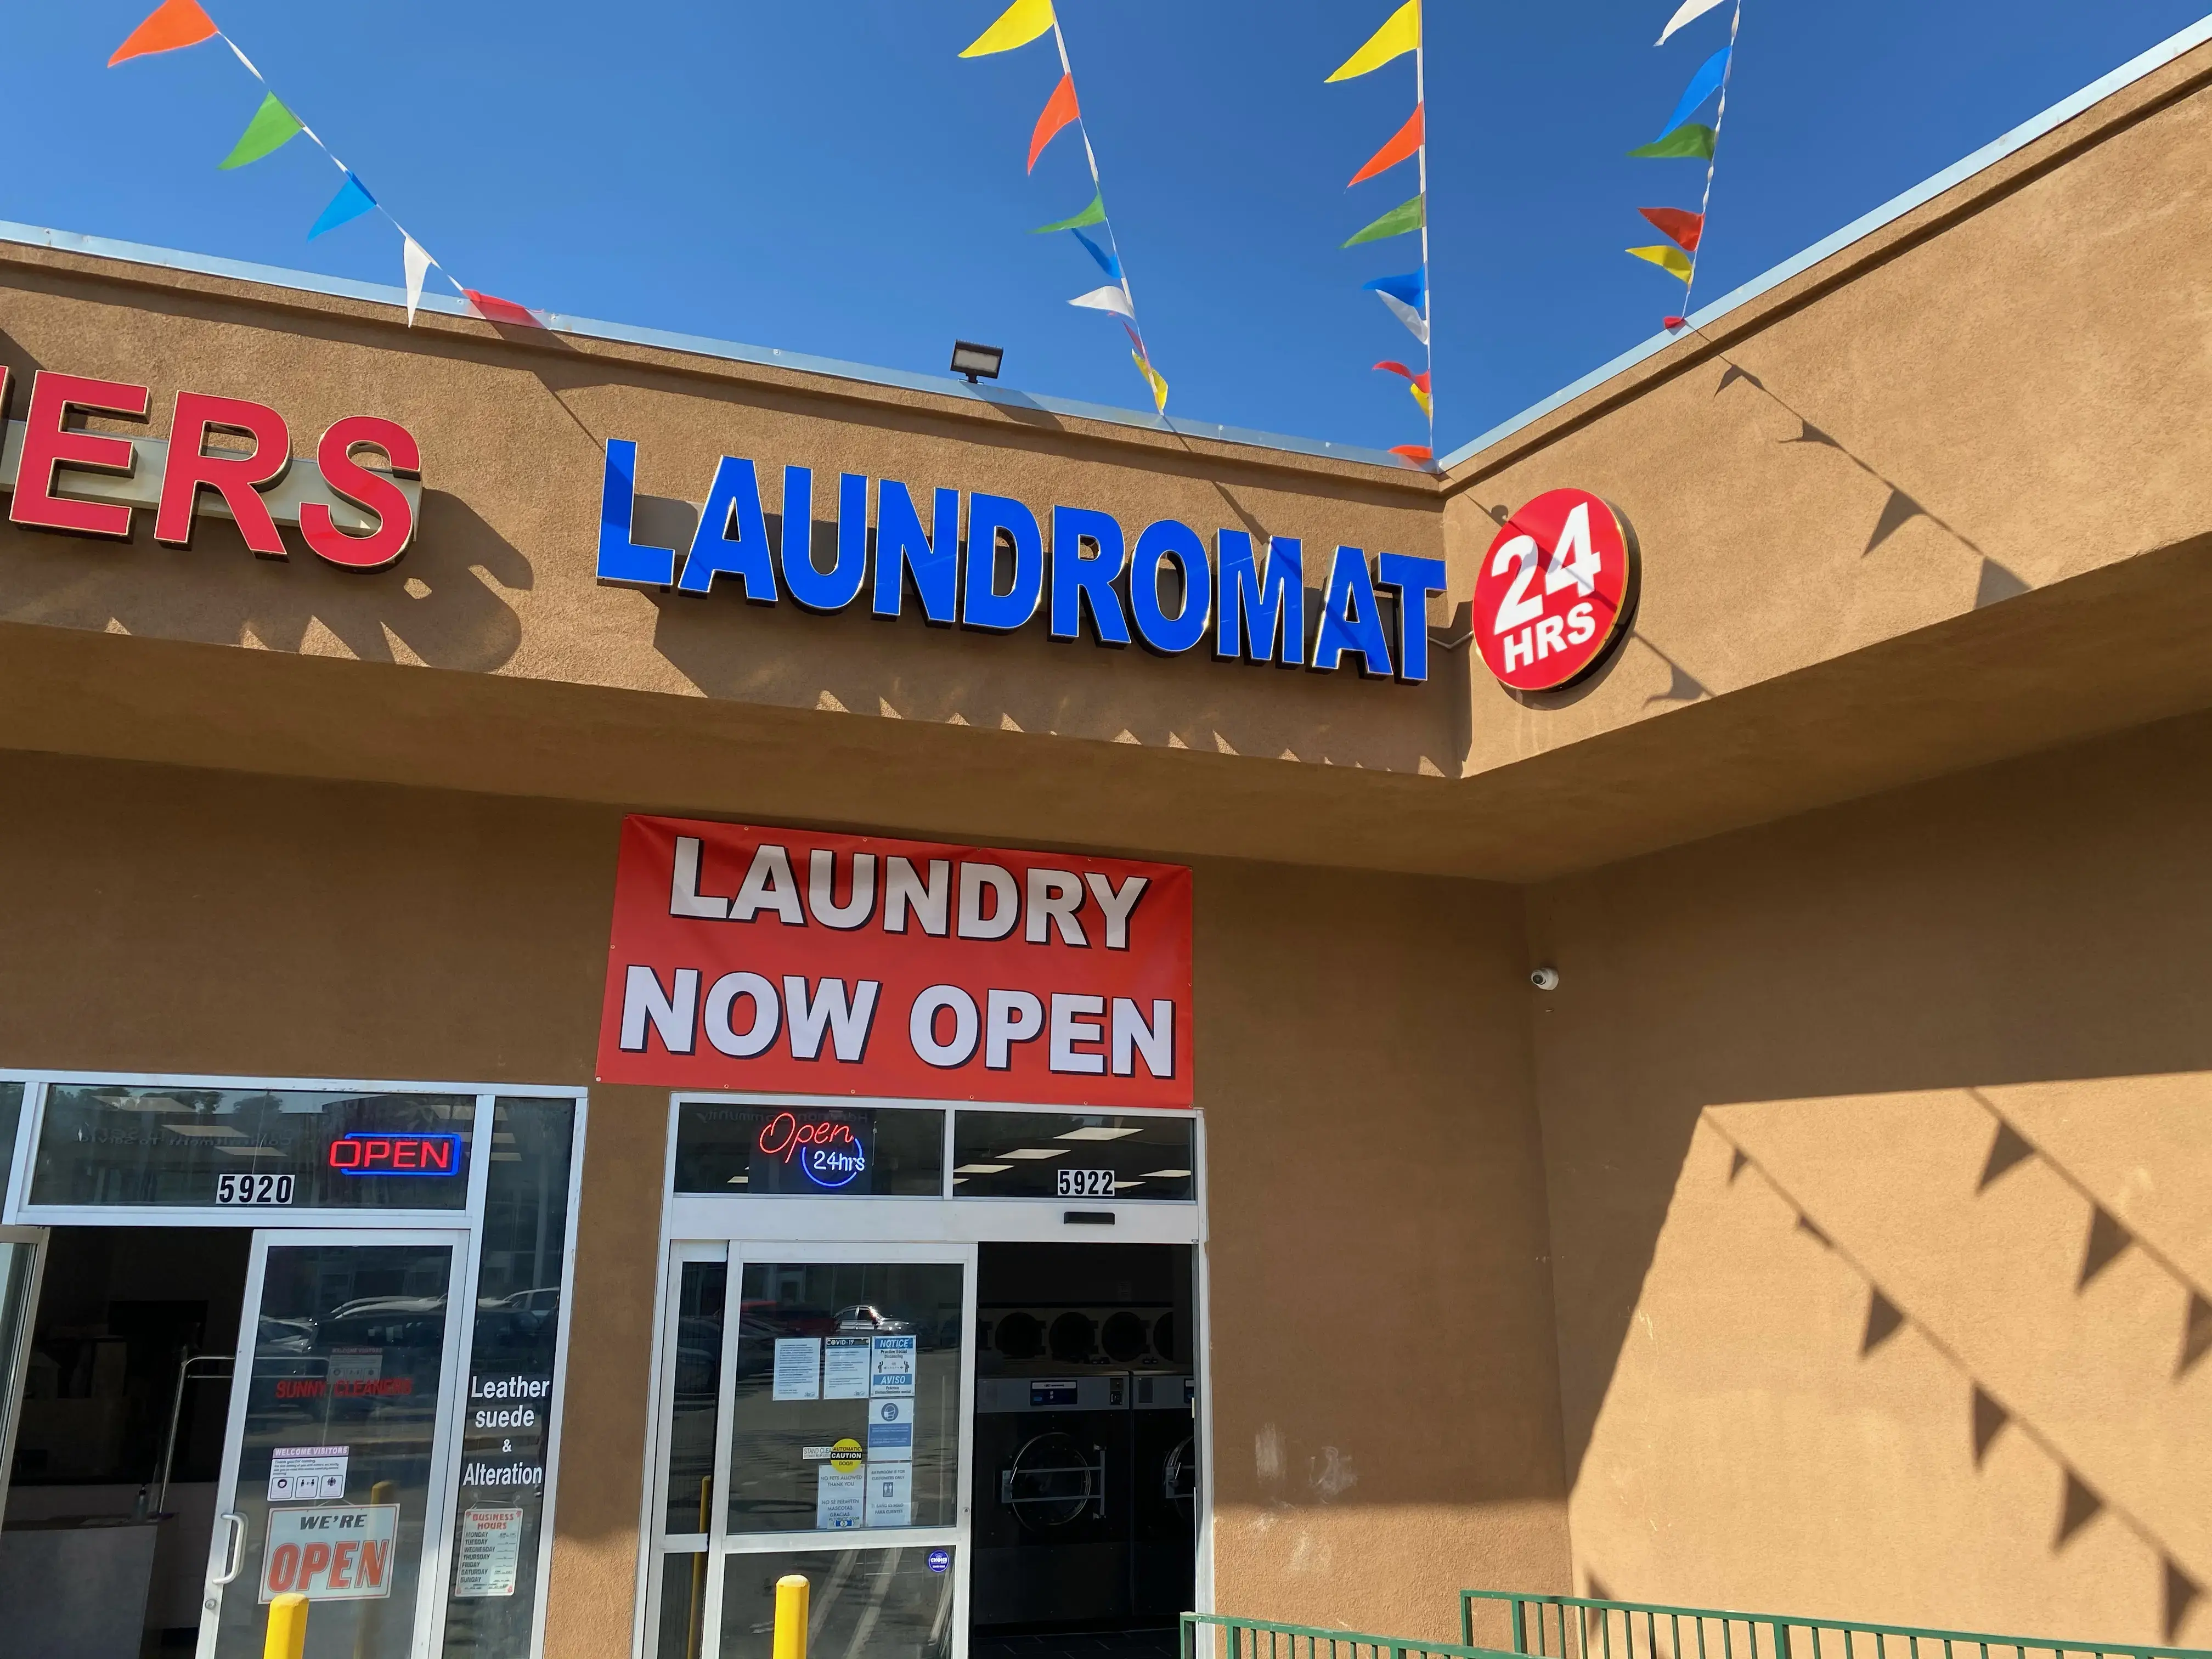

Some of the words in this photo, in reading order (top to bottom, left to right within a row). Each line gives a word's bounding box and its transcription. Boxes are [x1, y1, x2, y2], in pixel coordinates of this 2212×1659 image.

[0, 364, 421, 568] ERS
[596, 437, 1447, 684] LAUNDROMAT
[1492, 501, 1601, 635] 24
[1504, 602, 1596, 673] HRS
[669, 836, 1151, 951] LAUNDRY
[619, 965, 882, 1064] NOW
[908, 984, 1177, 1079] OPEN
[759, 1113, 854, 1164] Open
[330, 1140, 449, 1168] OPEN
[814, 1150, 865, 1171] 24hrs
[219, 1175, 292, 1203] 5920
[1059, 1170, 1113, 1195] 5922
[879, 1339, 910, 1348] NOTICE
[275, 1380, 326, 1398] SUNNY
[334, 1377, 413, 1397] CLEANERS
[471, 1375, 550, 1398] Leather
[880, 1375, 906, 1385] AVISO
[475, 1405, 534, 1428] suede
[275, 1448, 311, 1457] WELCOME
[313, 1447, 348, 1455] VISITORS
[502, 1438, 512, 1453] &
[462, 1462, 543, 1486] Alteration
[300, 1514, 368, 1530] WE'RE
[472, 1513, 514, 1521] BUSINESS
[477, 1522, 507, 1530] HOURS
[267, 1539, 390, 1593] OPEN
